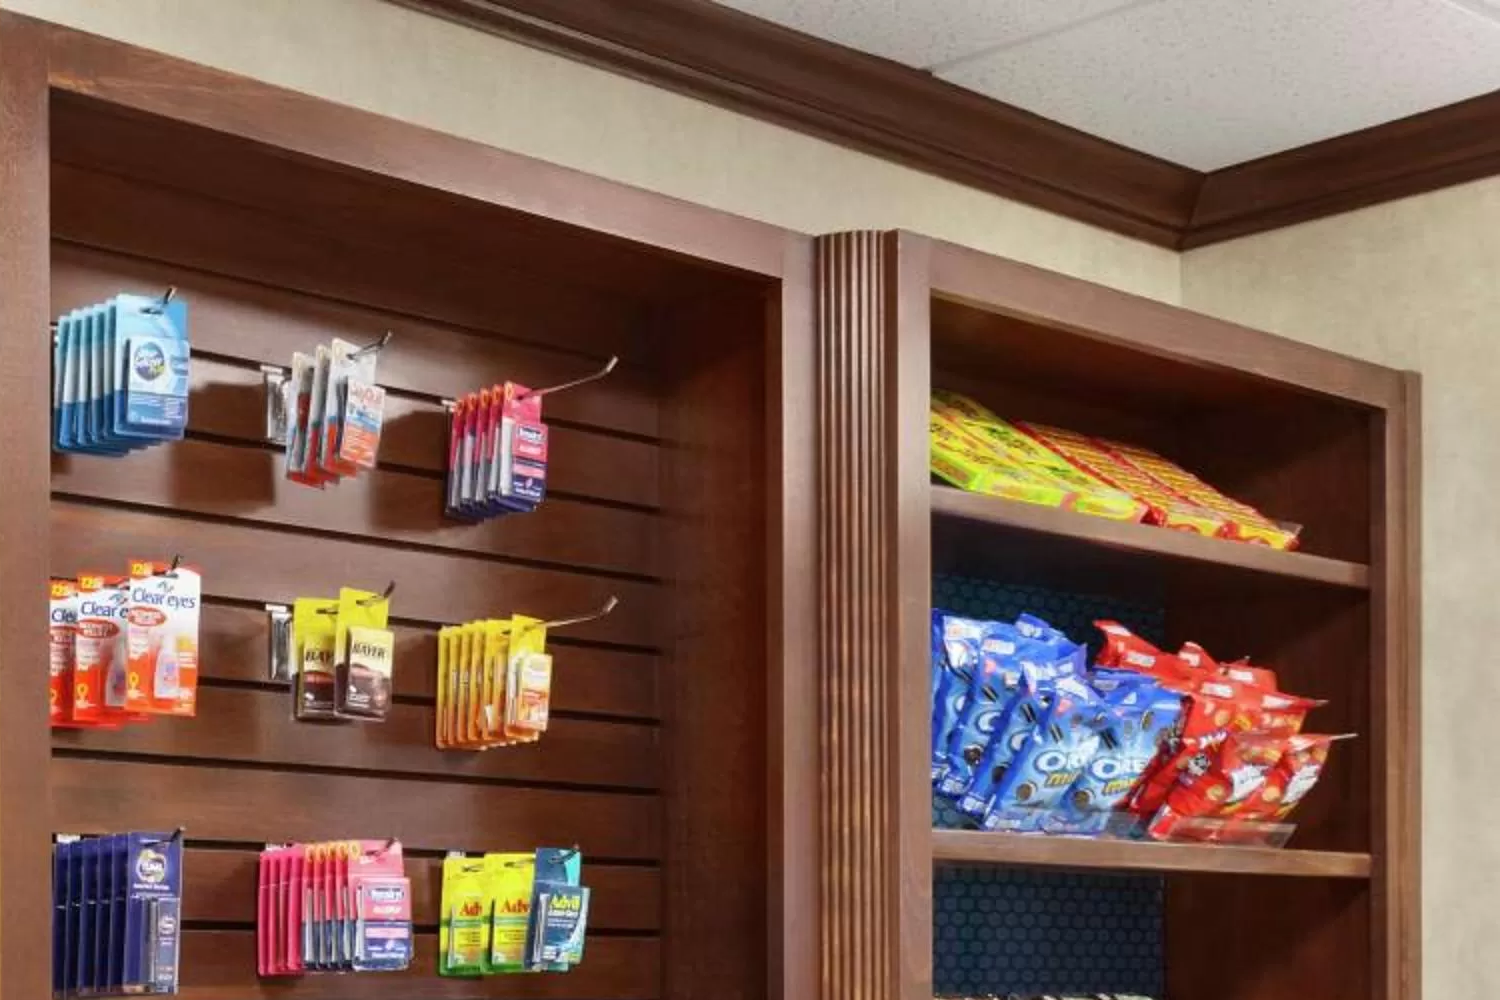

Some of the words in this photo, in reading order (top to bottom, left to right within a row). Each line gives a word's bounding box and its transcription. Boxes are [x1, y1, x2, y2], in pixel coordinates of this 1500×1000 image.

[131, 587, 166, 606] Clear
[167, 593, 197, 612] eyes
[51, 607, 78, 624] Cle
[80, 600, 116, 617] Clear
[1090, 757, 1148, 781] ORE
[460, 901, 482, 916] Adv
[500, 899, 531, 914] Adv
